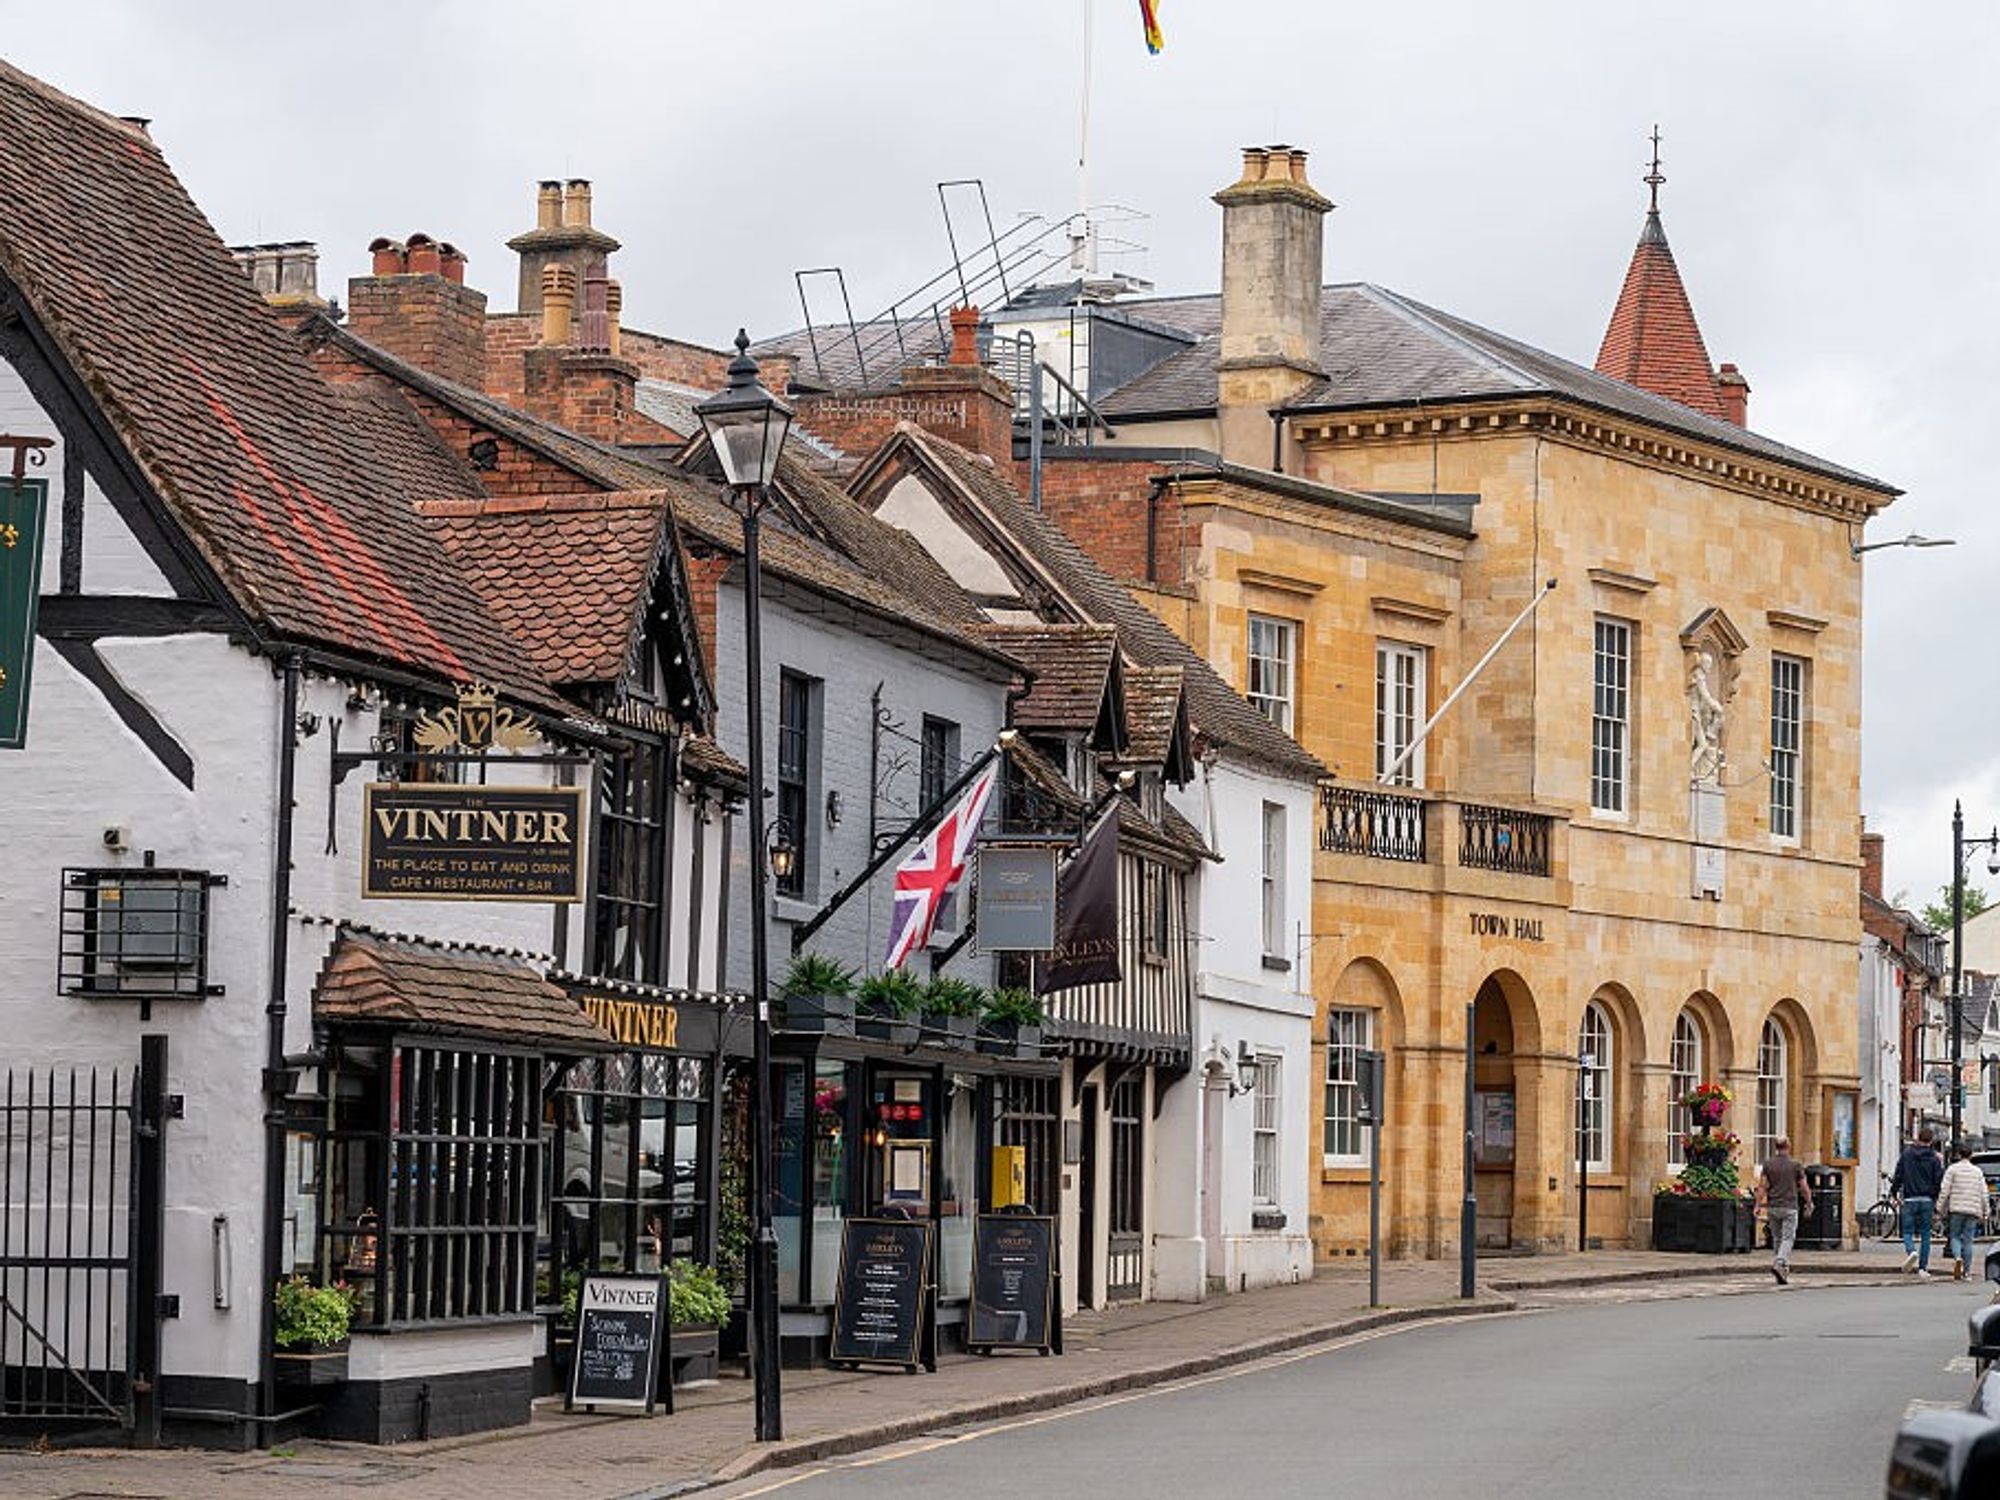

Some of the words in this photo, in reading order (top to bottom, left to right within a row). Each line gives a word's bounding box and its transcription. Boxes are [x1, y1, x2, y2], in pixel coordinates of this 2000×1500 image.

[463, 710, 491, 744] V
[374, 808, 571, 843] VINTNER
[375, 859, 399, 871] THE
[403, 859, 446, 872] PLACE
[449, 861, 468, 872] TO
[471, 862, 497, 872] EAT
[500, 862, 528, 873] AND
[531, 863, 570, 874] DRINK
[390, 877, 421, 887] CAFE
[433, 877, 514, 890] RESTAURANT
[526, 880, 553, 891] BAR
[1469, 912, 1510, 937] TOWN
[1514, 918, 1545, 942] HALL
[589, 1283, 656, 1305] VINTNER
